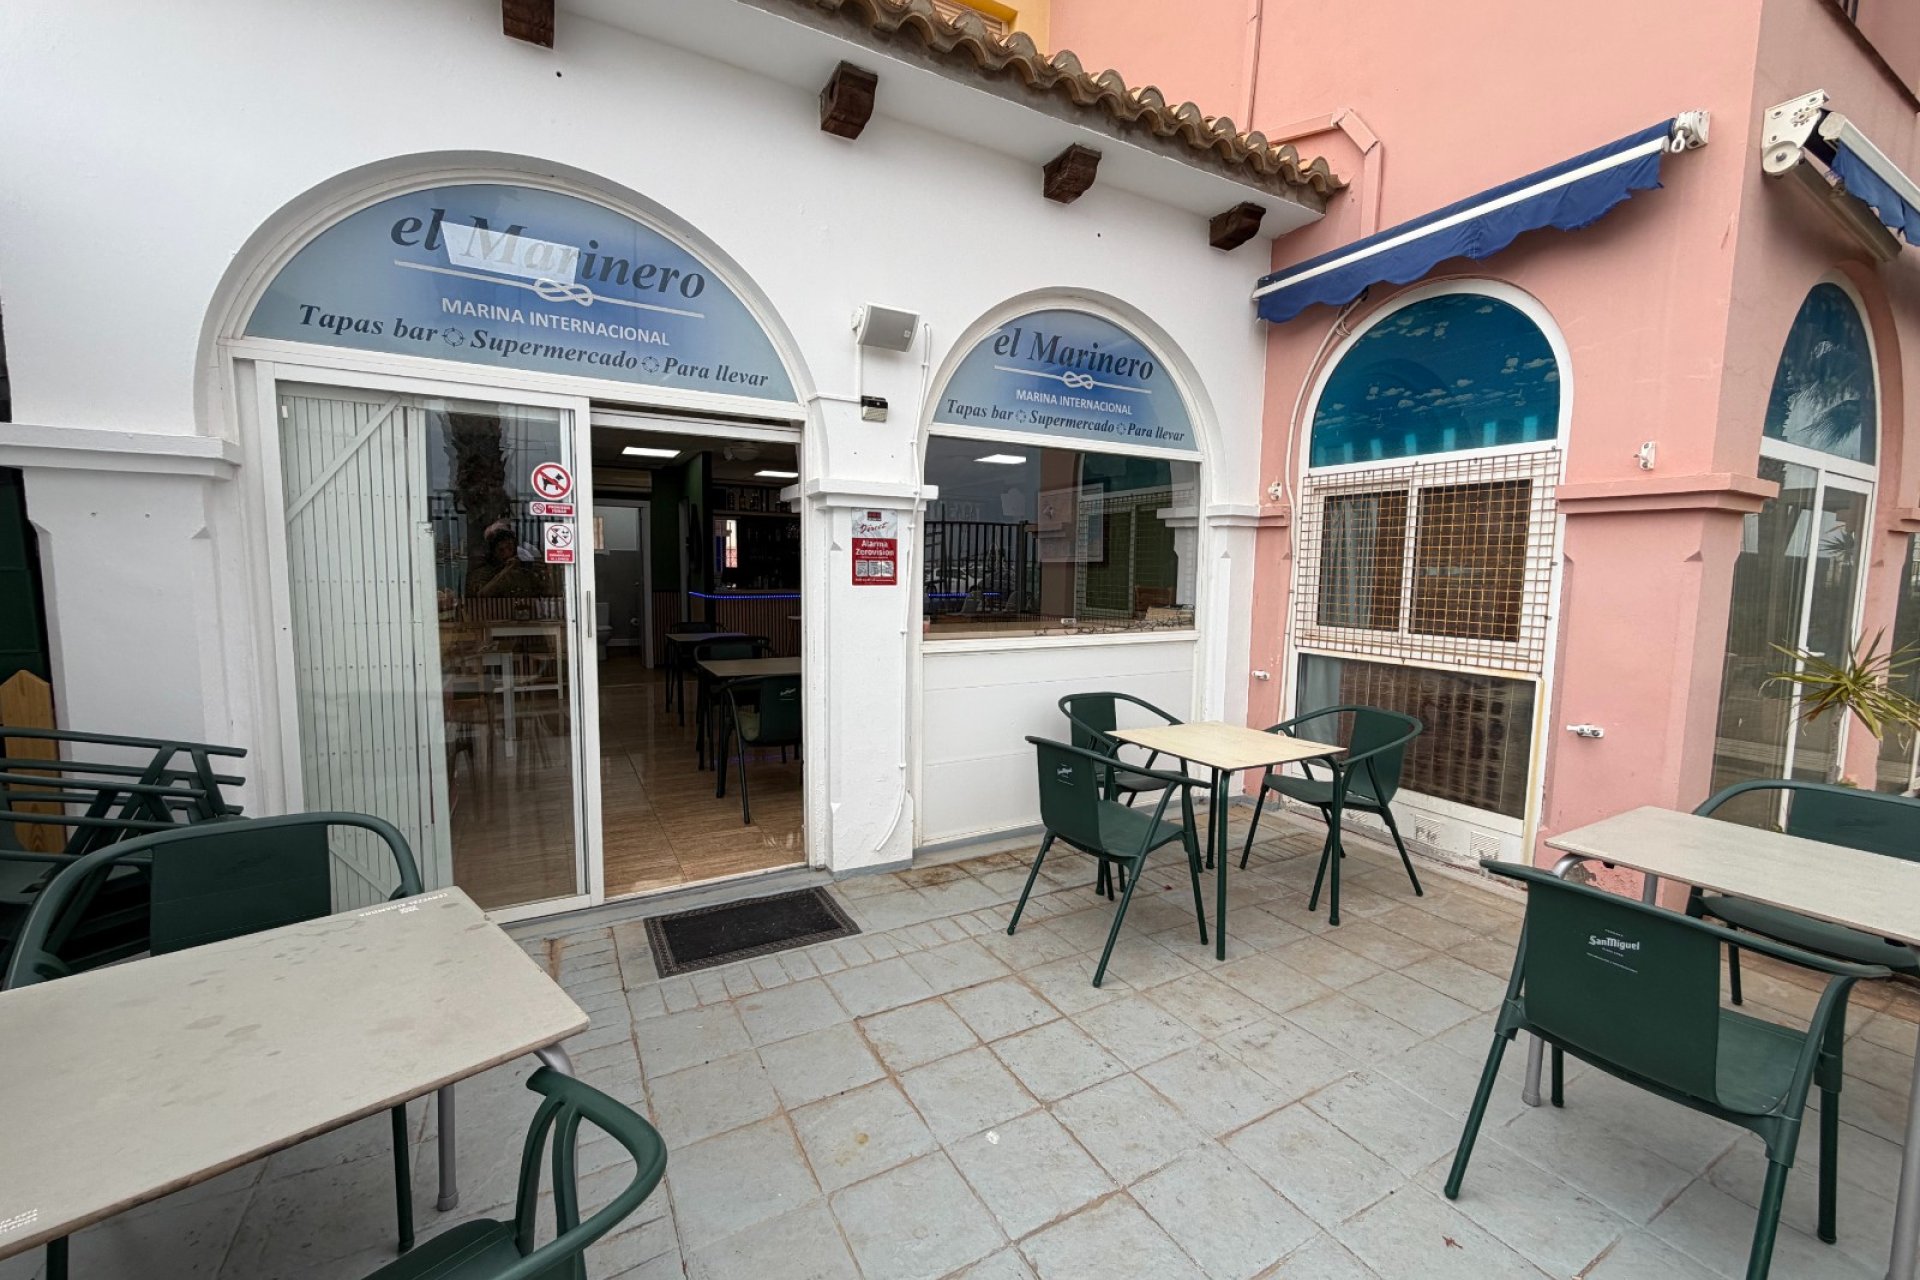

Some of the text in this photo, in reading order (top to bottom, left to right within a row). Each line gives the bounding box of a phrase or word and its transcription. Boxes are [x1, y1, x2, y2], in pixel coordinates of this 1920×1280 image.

[390, 207, 706, 299] el Marinero
[299, 303, 769, 387] Tapas bar Supermercado Para llevar
[442, 297, 671, 346] MARINA INTERNACIONAL
[993, 327, 1154, 381] el Marinero
[947, 399, 1185, 442] Tapas bar Supermercado Para llevar
[1015, 389, 1133, 416] MARINA INTERNACIONAL
[861, 540, 888, 549] Alarma
